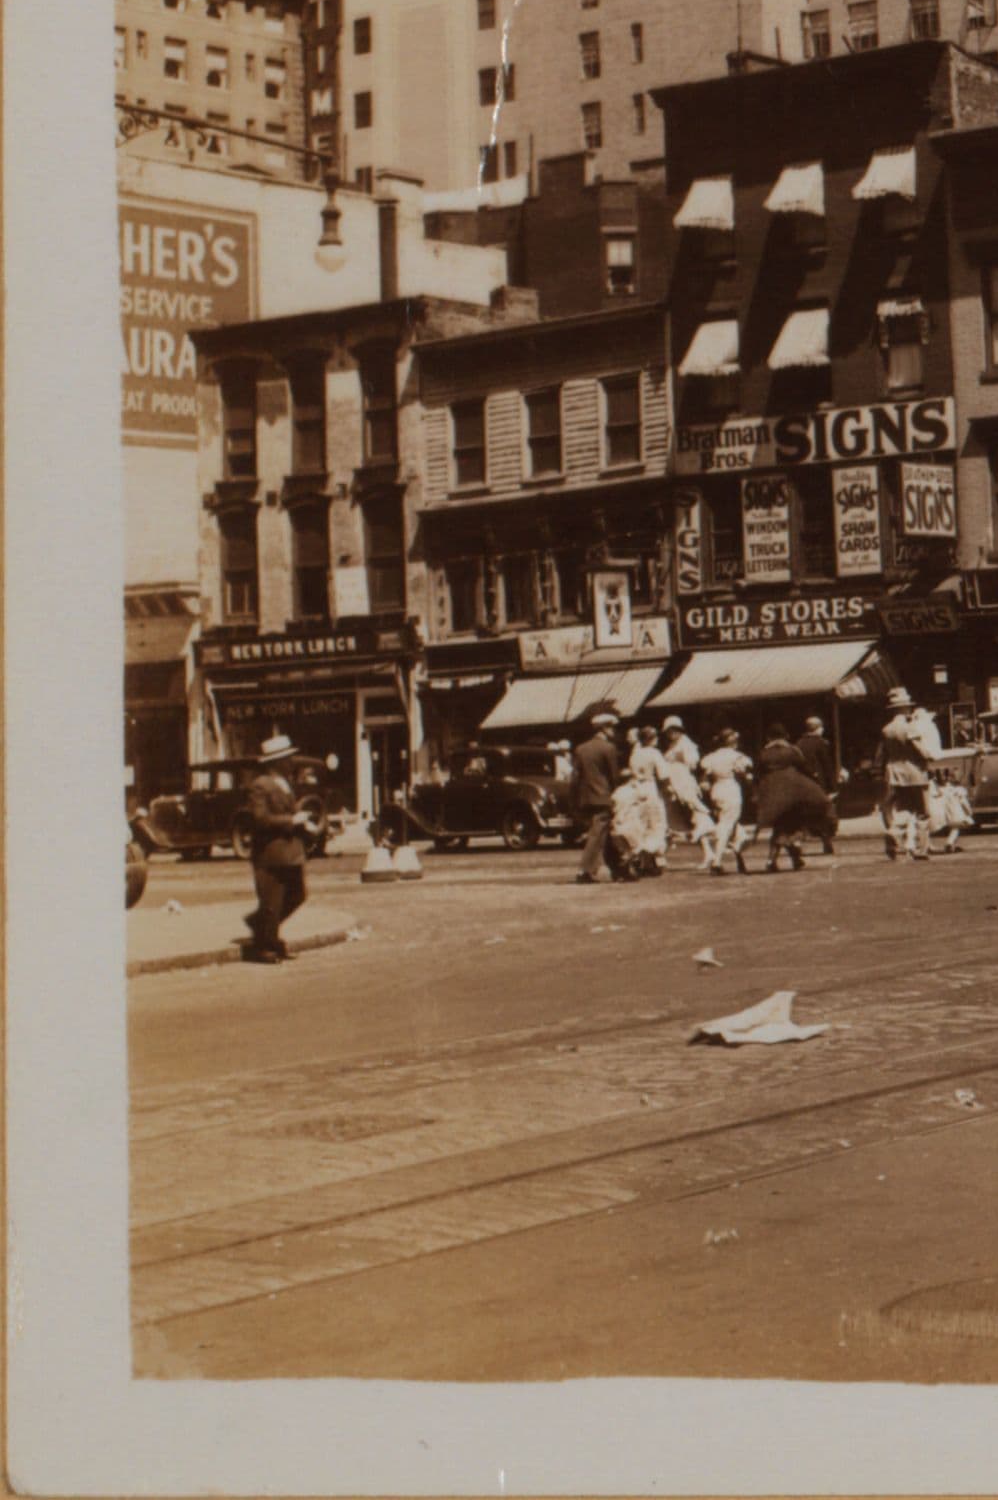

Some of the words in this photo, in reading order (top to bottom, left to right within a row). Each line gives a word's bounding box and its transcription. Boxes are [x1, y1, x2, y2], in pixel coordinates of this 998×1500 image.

[123, 221, 239, 288] HER'S
[120, 285, 213, 321] SERVICE
[674, 421, 771, 451] Bratman
[774, 400, 949, 463] SIGNS
[835, 484, 879, 514] SIGNS
[904, 485, 954, 534] SIGNS
[745, 520, 788, 535] WINDOW
[841, 521, 876, 536] SHOW
[677, 492, 700, 591] SIGNS
[748, 542, 787, 557] TRUCK
[838, 536, 880, 553] CARDS
[687, 604, 749, 629] GILD
[783, 621, 841, 638] WEAR
[232, 644, 262, 660] NEW
[264, 640, 304, 657] YORK
[307, 636, 357, 653] LUNCH
